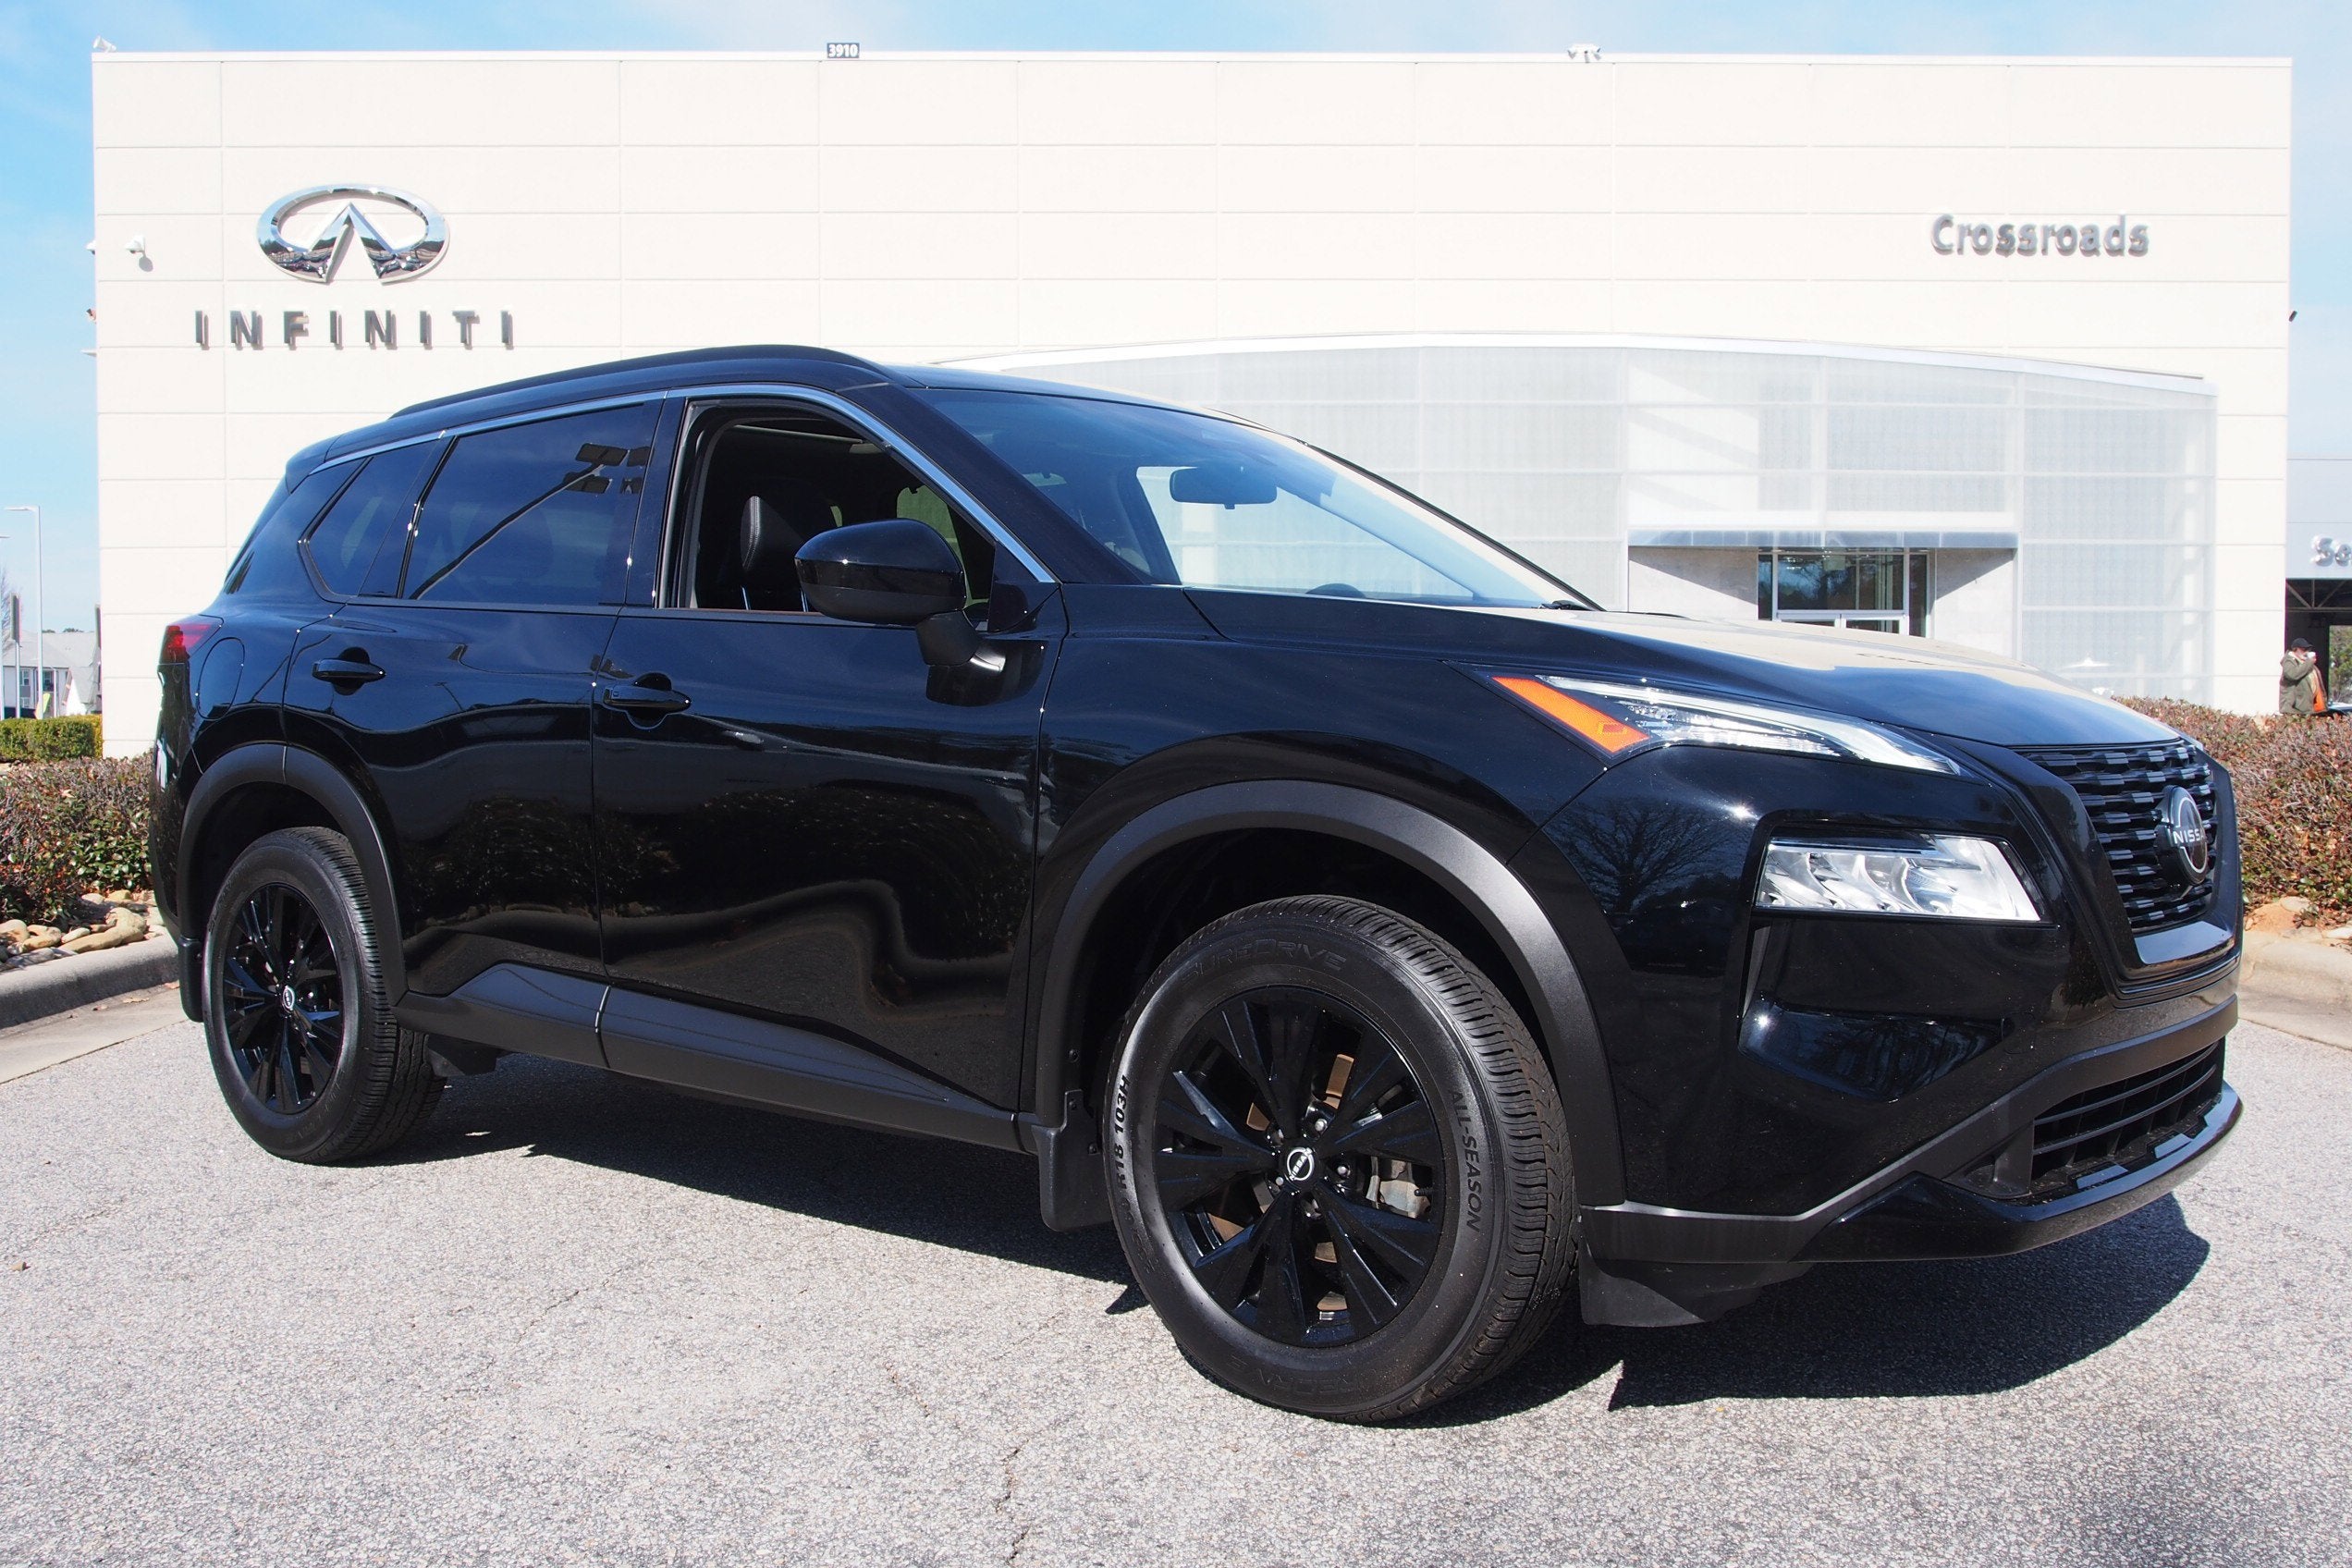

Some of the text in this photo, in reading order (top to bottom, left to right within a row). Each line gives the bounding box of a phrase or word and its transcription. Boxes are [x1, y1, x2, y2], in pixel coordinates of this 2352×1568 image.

[827, 43, 859, 58] 3910
[1931, 214, 2150, 257] Crossroads
[195, 310, 514, 350] INFINITI
[2313, 535, 2352, 568] Se
[1114, 1073, 1132, 1134] 103H
[1448, 1089, 1483, 1233] ALL-SEASON
